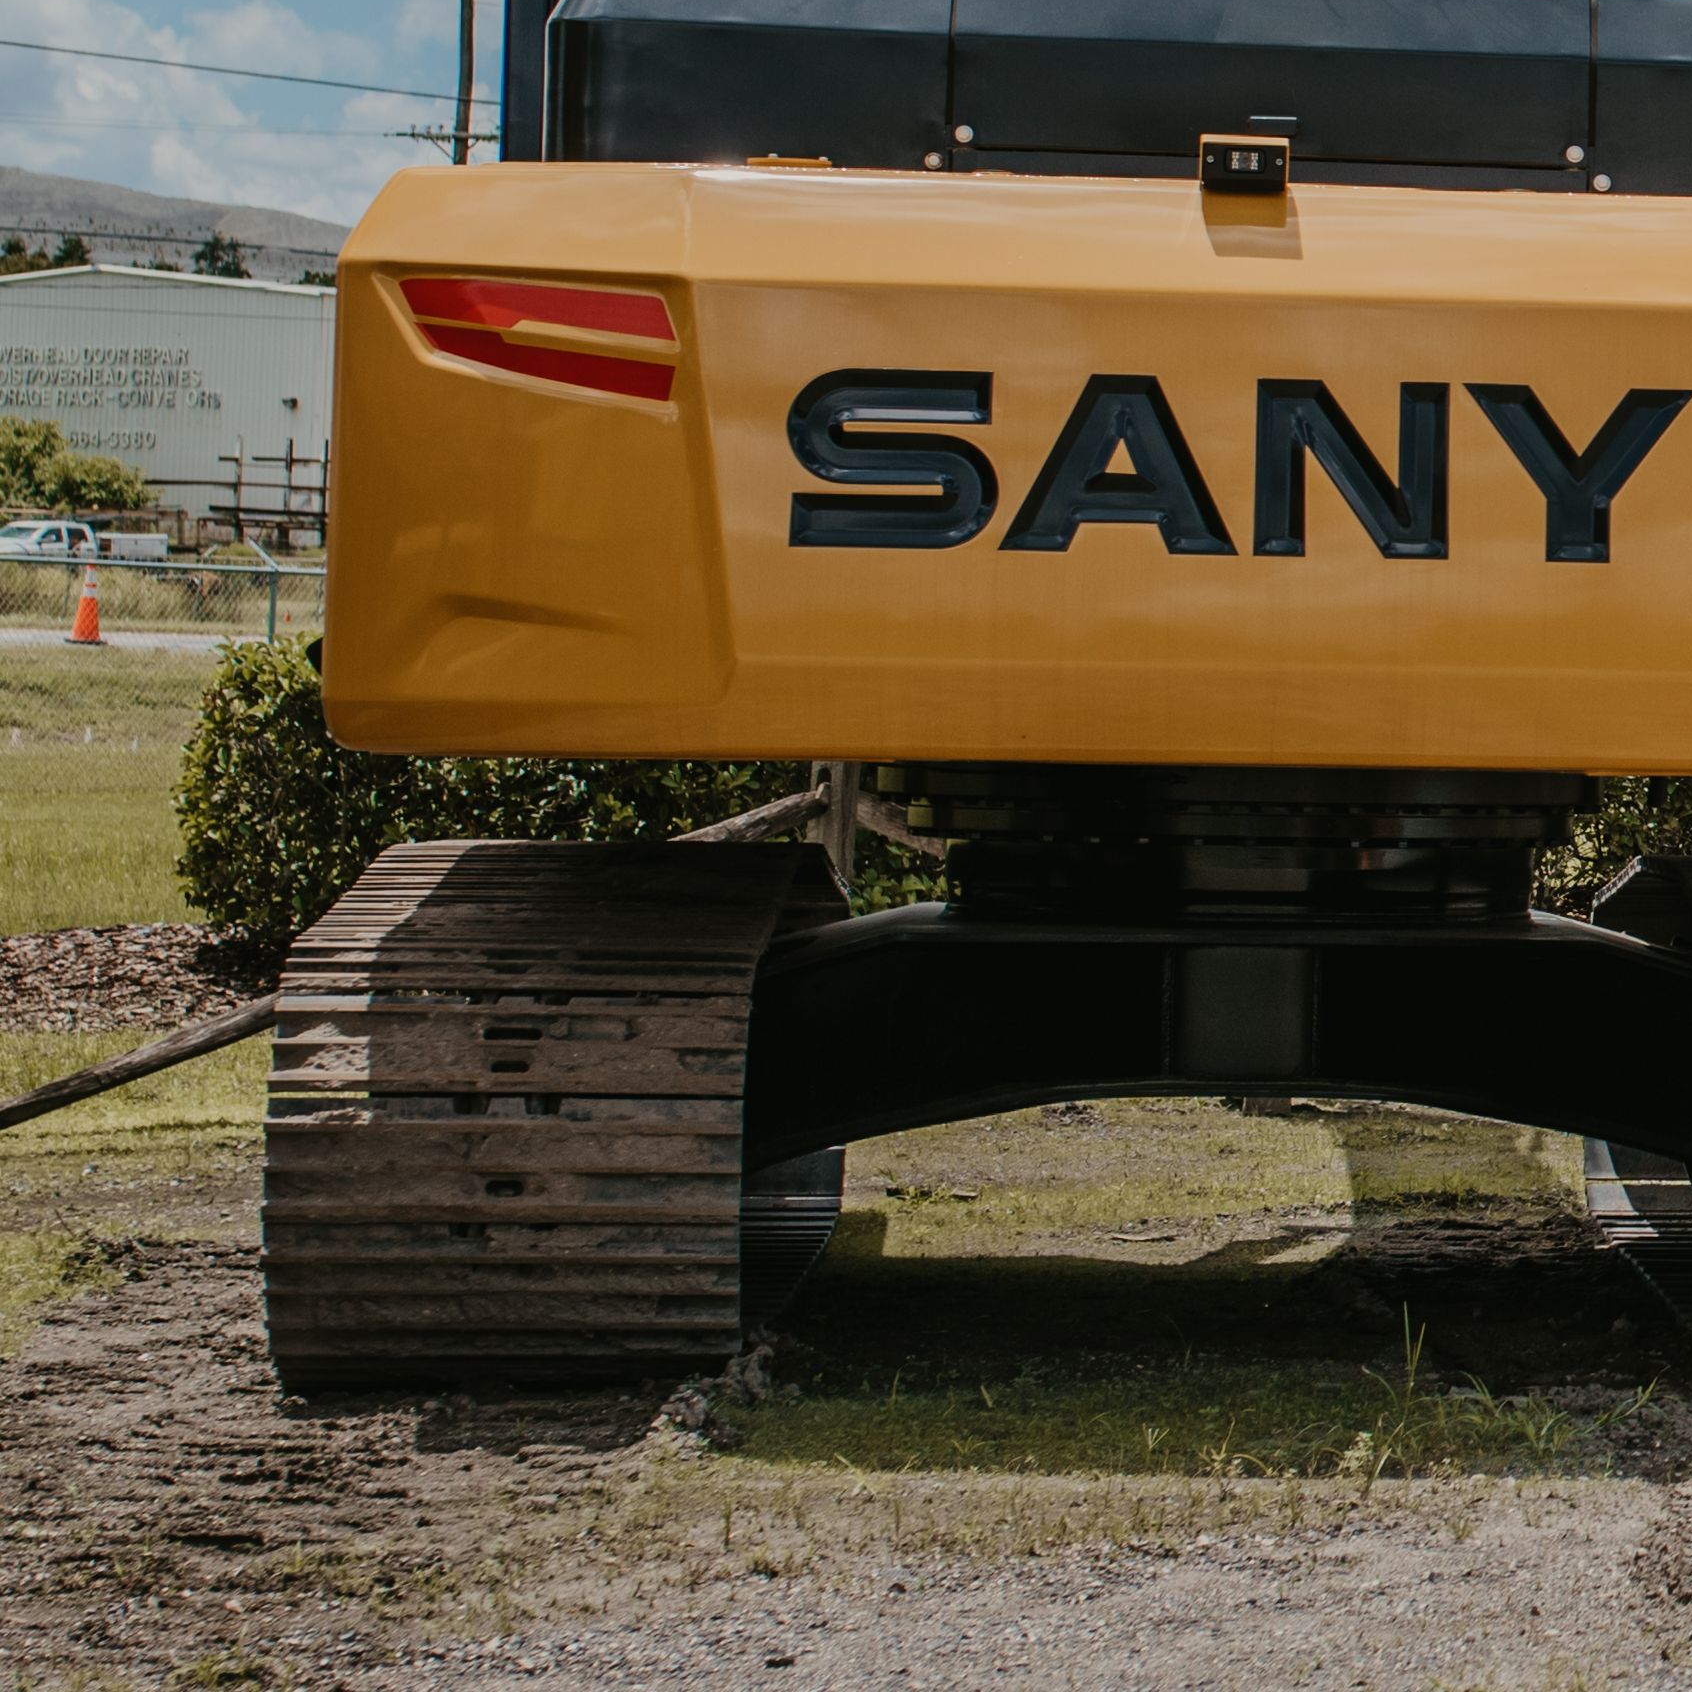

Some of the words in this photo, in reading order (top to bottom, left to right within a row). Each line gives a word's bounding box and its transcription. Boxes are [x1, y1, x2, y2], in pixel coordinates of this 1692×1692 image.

[82, 345, 129, 365] DOOR
[132, 345, 190, 365] REPAIR
[130, 367, 202, 388] CRANES
